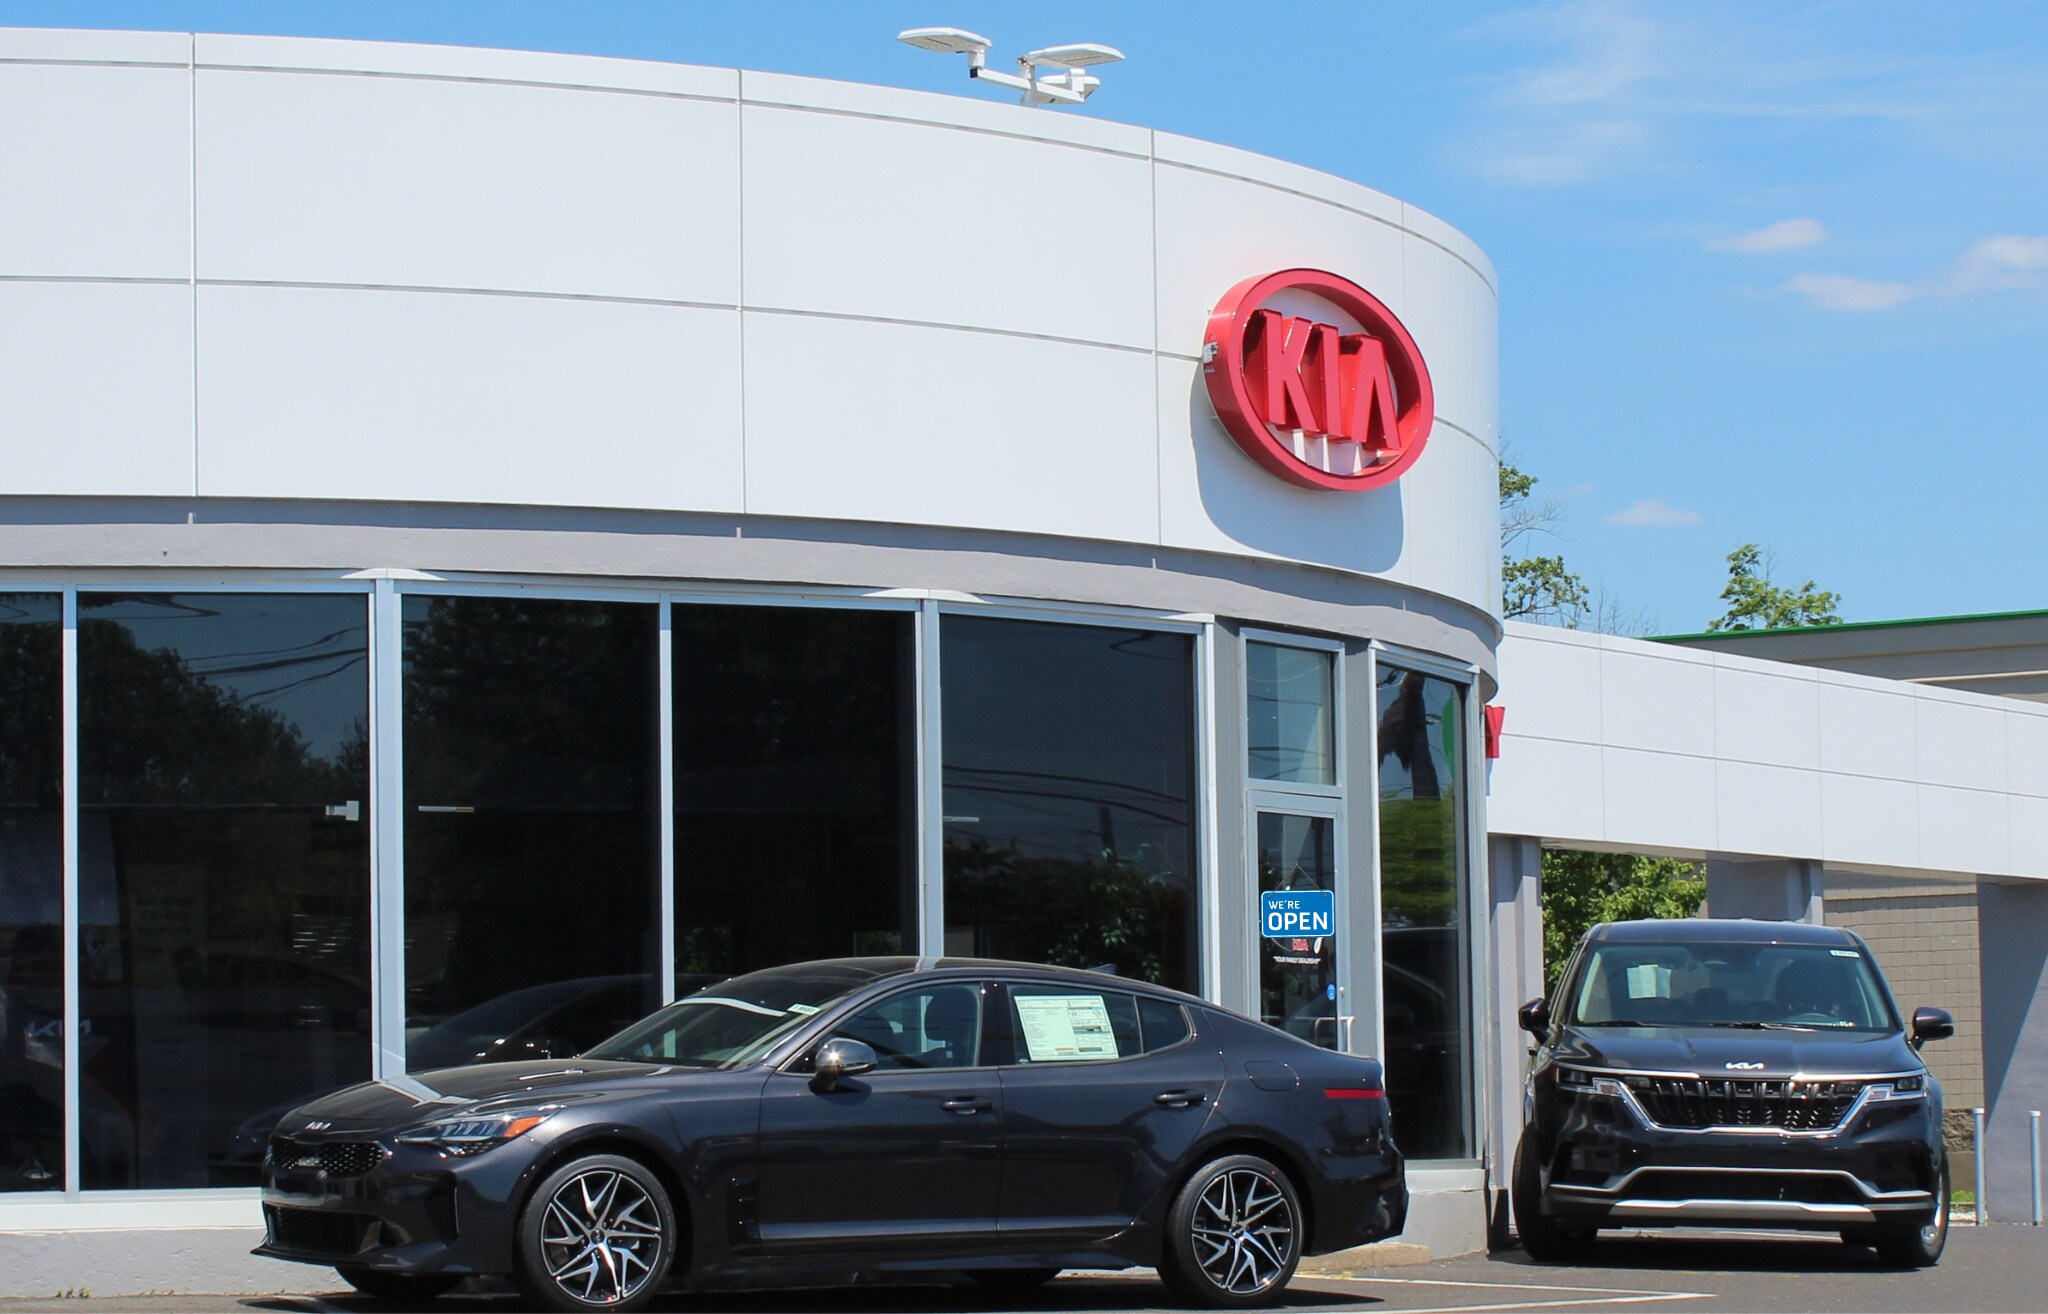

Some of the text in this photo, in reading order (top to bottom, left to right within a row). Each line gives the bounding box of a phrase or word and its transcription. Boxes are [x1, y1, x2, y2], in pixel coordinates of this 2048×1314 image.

[1256, 308, 1402, 451] KIA
[1268, 900, 1300, 910] WE'RE
[1268, 911, 1328, 931] OPEN
